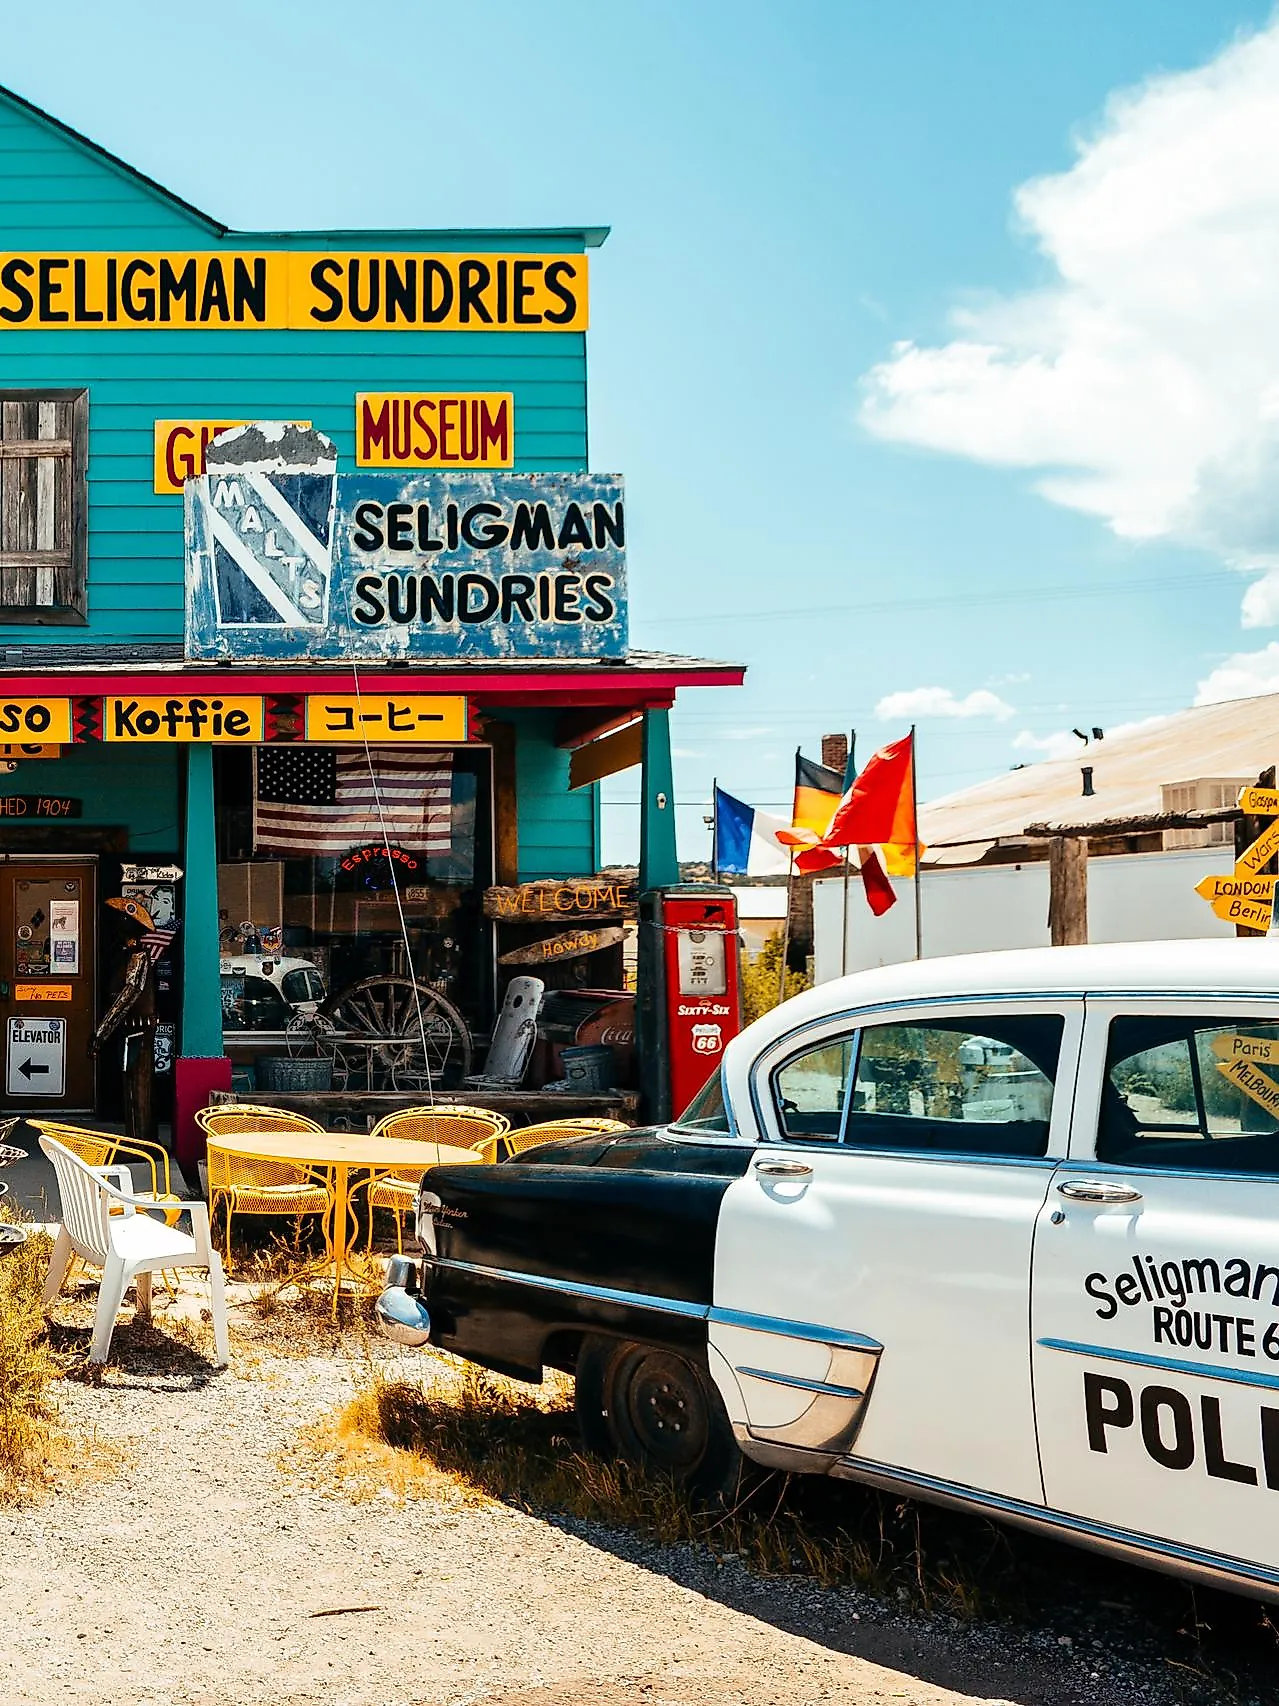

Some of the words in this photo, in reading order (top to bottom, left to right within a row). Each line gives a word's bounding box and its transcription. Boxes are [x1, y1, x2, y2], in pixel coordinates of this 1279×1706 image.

[0, 258, 266, 322] SELIGMAN
[310, 259, 577, 323] SUNDRIES
[362, 400, 508, 462] MUSEUM
[353, 502, 624, 552] SELIGMAN
[353, 573, 614, 624] SUNDRIES
[114, 700, 251, 737] Koffie
[324, 702, 445, 732] コーヒー
[36, 799, 71, 816] 1904
[341, 846, 418, 871] Espresso
[497, 885, 630, 914] WELCOME
[543, 934, 598, 957] Howdy
[13, 1030, 60, 1043] ELEVATOR
[696, 1037, 717, 1049] 66
[1233, 1038, 1271, 1058] Paris
[1084, 1254, 1279, 1320] Seligman
[1154, 1306, 1256, 1358] ROUTE
